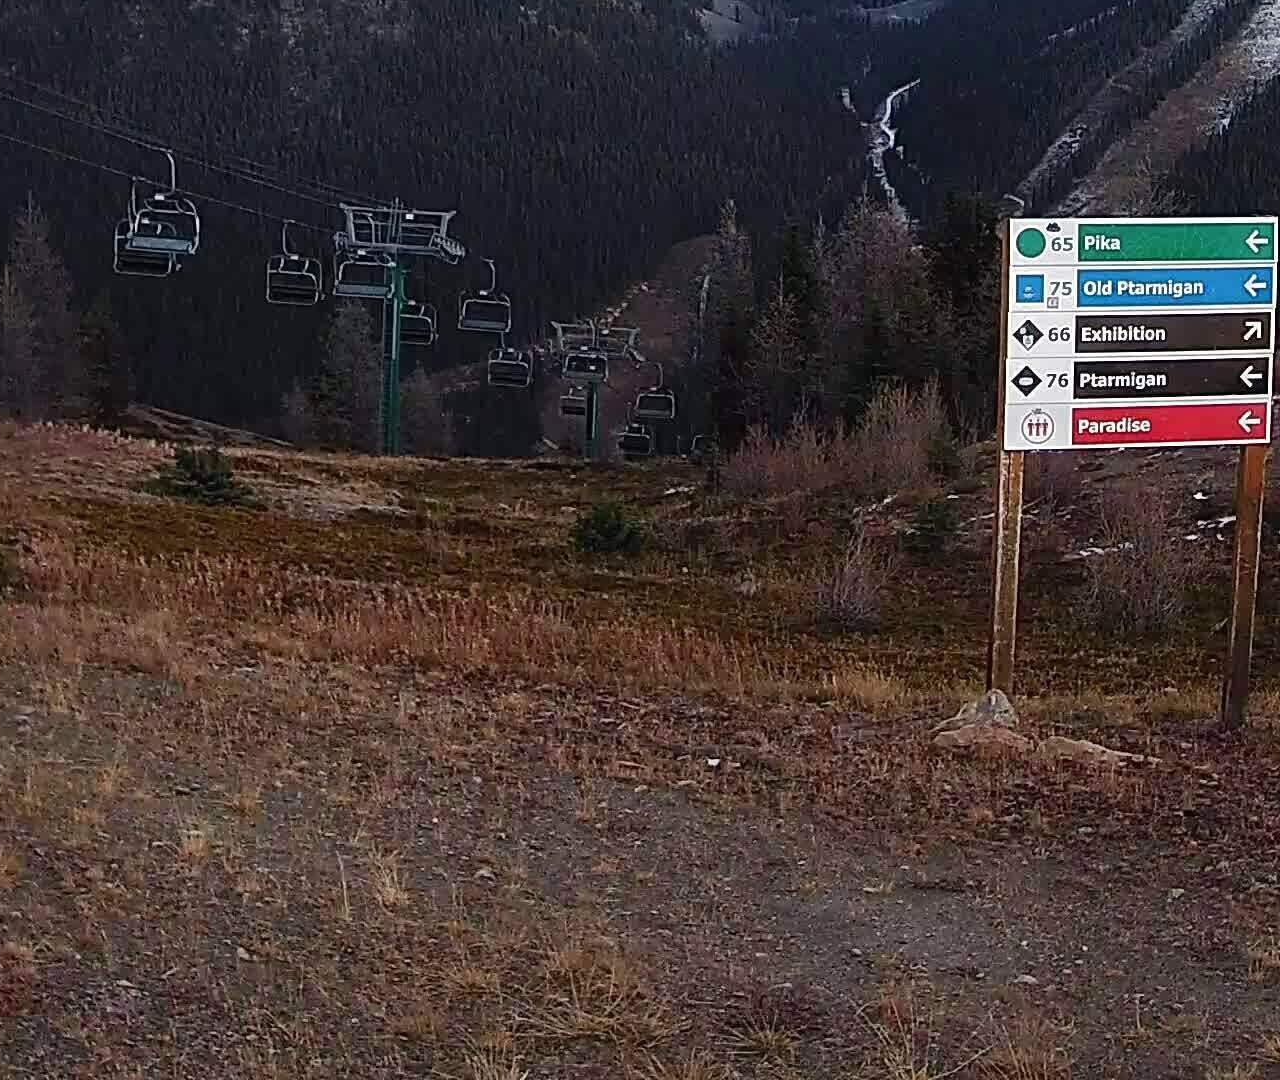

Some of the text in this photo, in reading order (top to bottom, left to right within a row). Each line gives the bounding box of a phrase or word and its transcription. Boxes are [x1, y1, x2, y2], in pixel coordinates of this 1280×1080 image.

[1051, 235, 1120, 252] 65 Pika
[1050, 279, 1204, 298] 75 Old Ptarmigan
[1048, 326, 1166, 342] 66 Exhibition
[1046, 372, 1167, 390] 76 Ptarmigan
[1078, 418, 1151, 434] Paradise
